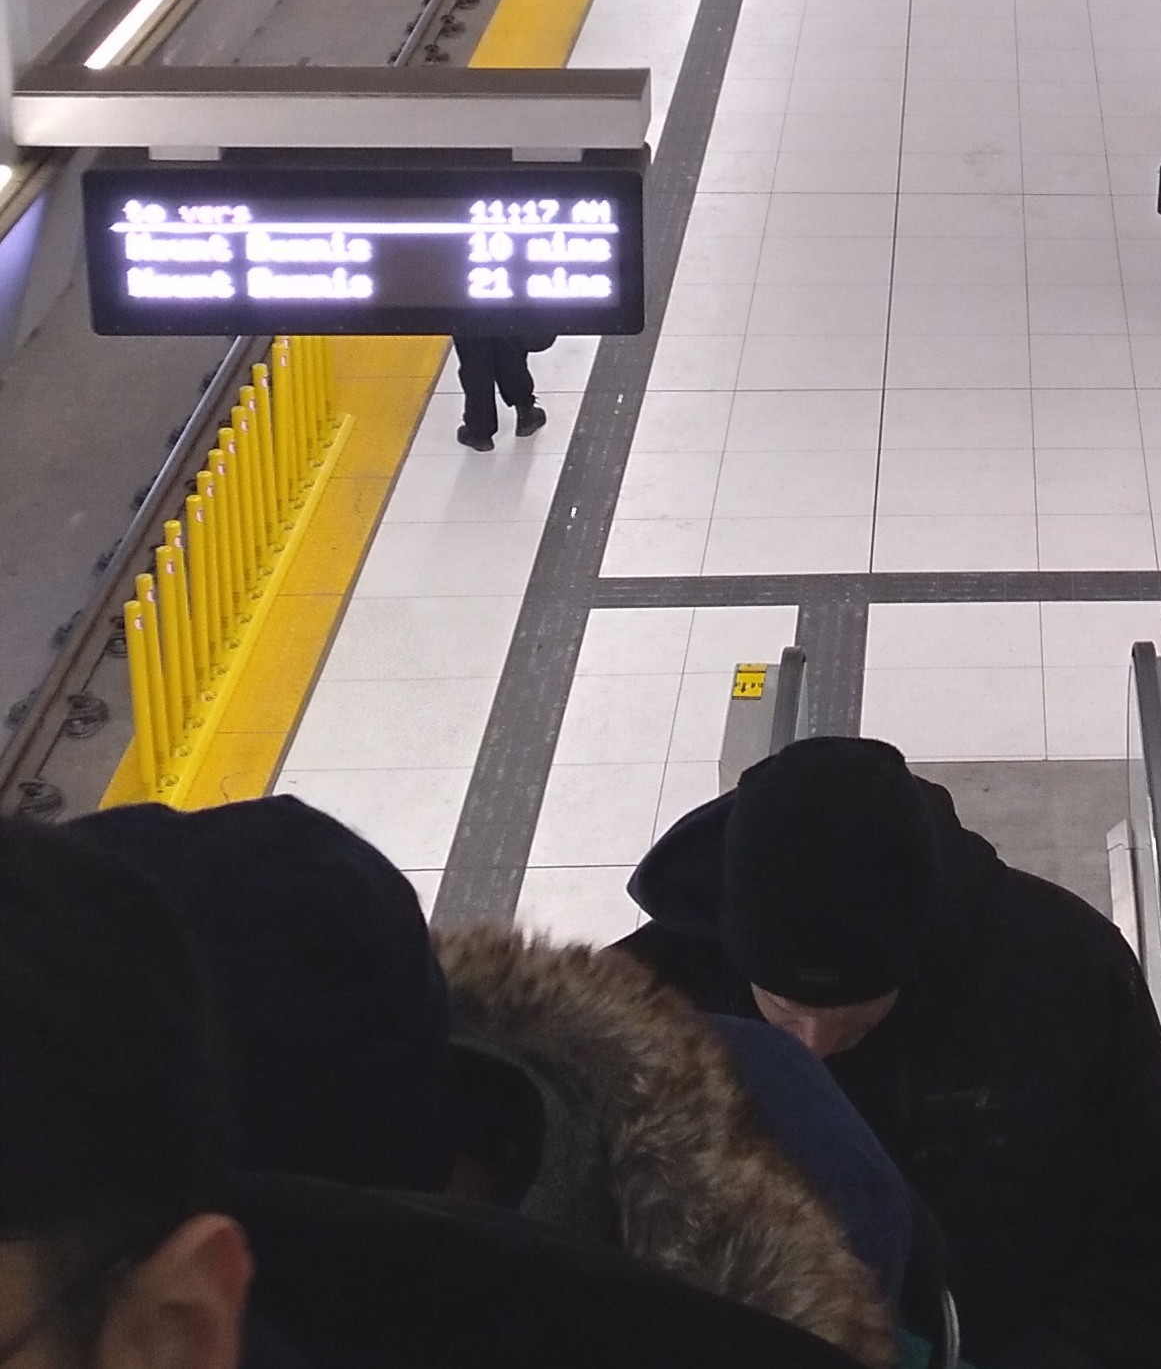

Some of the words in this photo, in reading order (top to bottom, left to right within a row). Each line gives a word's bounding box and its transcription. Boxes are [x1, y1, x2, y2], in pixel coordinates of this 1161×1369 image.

[469, 199, 559, 224] 11:17
[572, 200, 611, 224] AM
[468, 231, 514, 263] 10
[526, 231, 612, 263] mins
[468, 266, 514, 299] 21
[526, 266, 612, 298] mins
